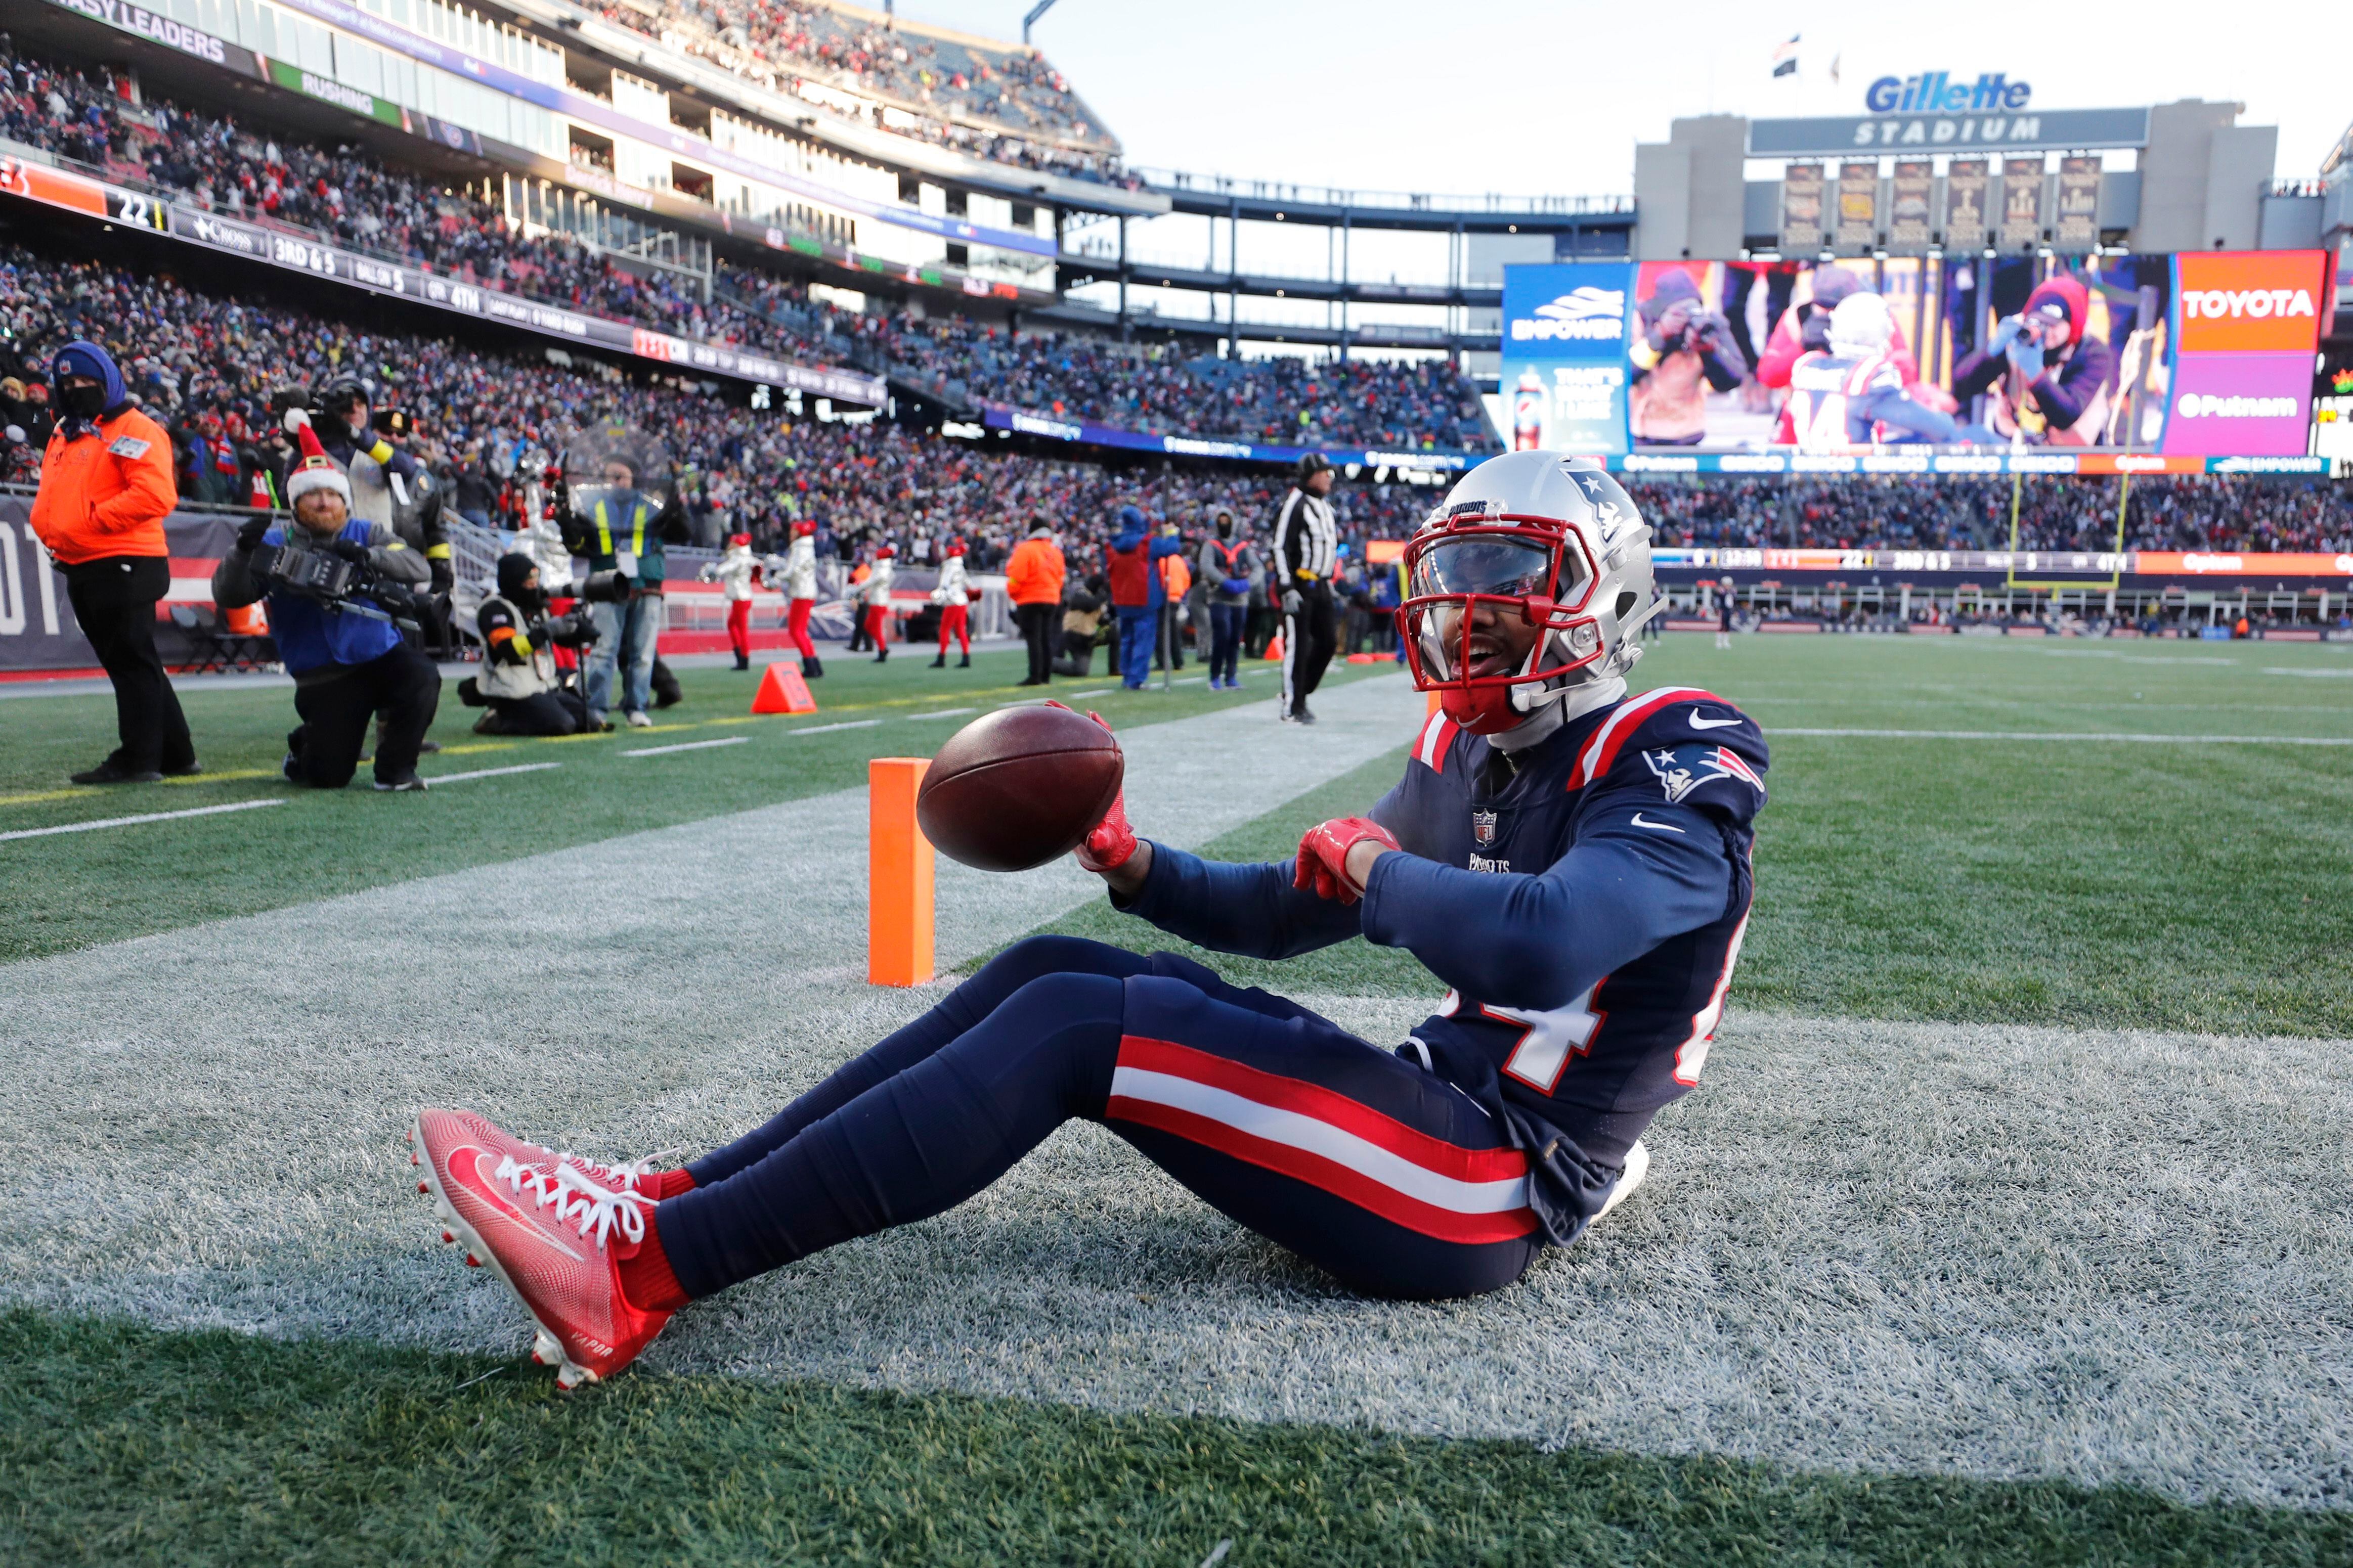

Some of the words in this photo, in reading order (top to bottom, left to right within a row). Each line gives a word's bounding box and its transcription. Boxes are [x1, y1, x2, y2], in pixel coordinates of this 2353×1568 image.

[120, 3, 227, 64] LEADERS
[301, 71, 374, 116] RUSHING
[1866, 71, 2031, 118] Gillette
[1853, 116, 2041, 145] STADIUM
[118, 191, 151, 228] 22
[274, 238, 308, 267] 3RD
[324, 252, 336, 275] 5
[393, 268, 404, 293] 5
[451, 286, 480, 313] 4TH
[2182, 289, 2315, 319] TOYOTA
[1511, 318, 1623, 340] EMPOWER
[2200, 394, 2298, 418] Putnam
[2114, 455, 2166, 473] Optum
[2251, 457, 2322, 472] EMPOWER
[1842, 549, 1864, 569] 22
[1893, 552, 1924, 570] 3RD
[1939, 552, 1951, 571] 5
[2026, 552, 2037, 571] 5
[2183, 553, 2242, 574] Optum
[1477, 826, 1493, 839] NFL
[571, 1331, 614, 1358] VAPOR
